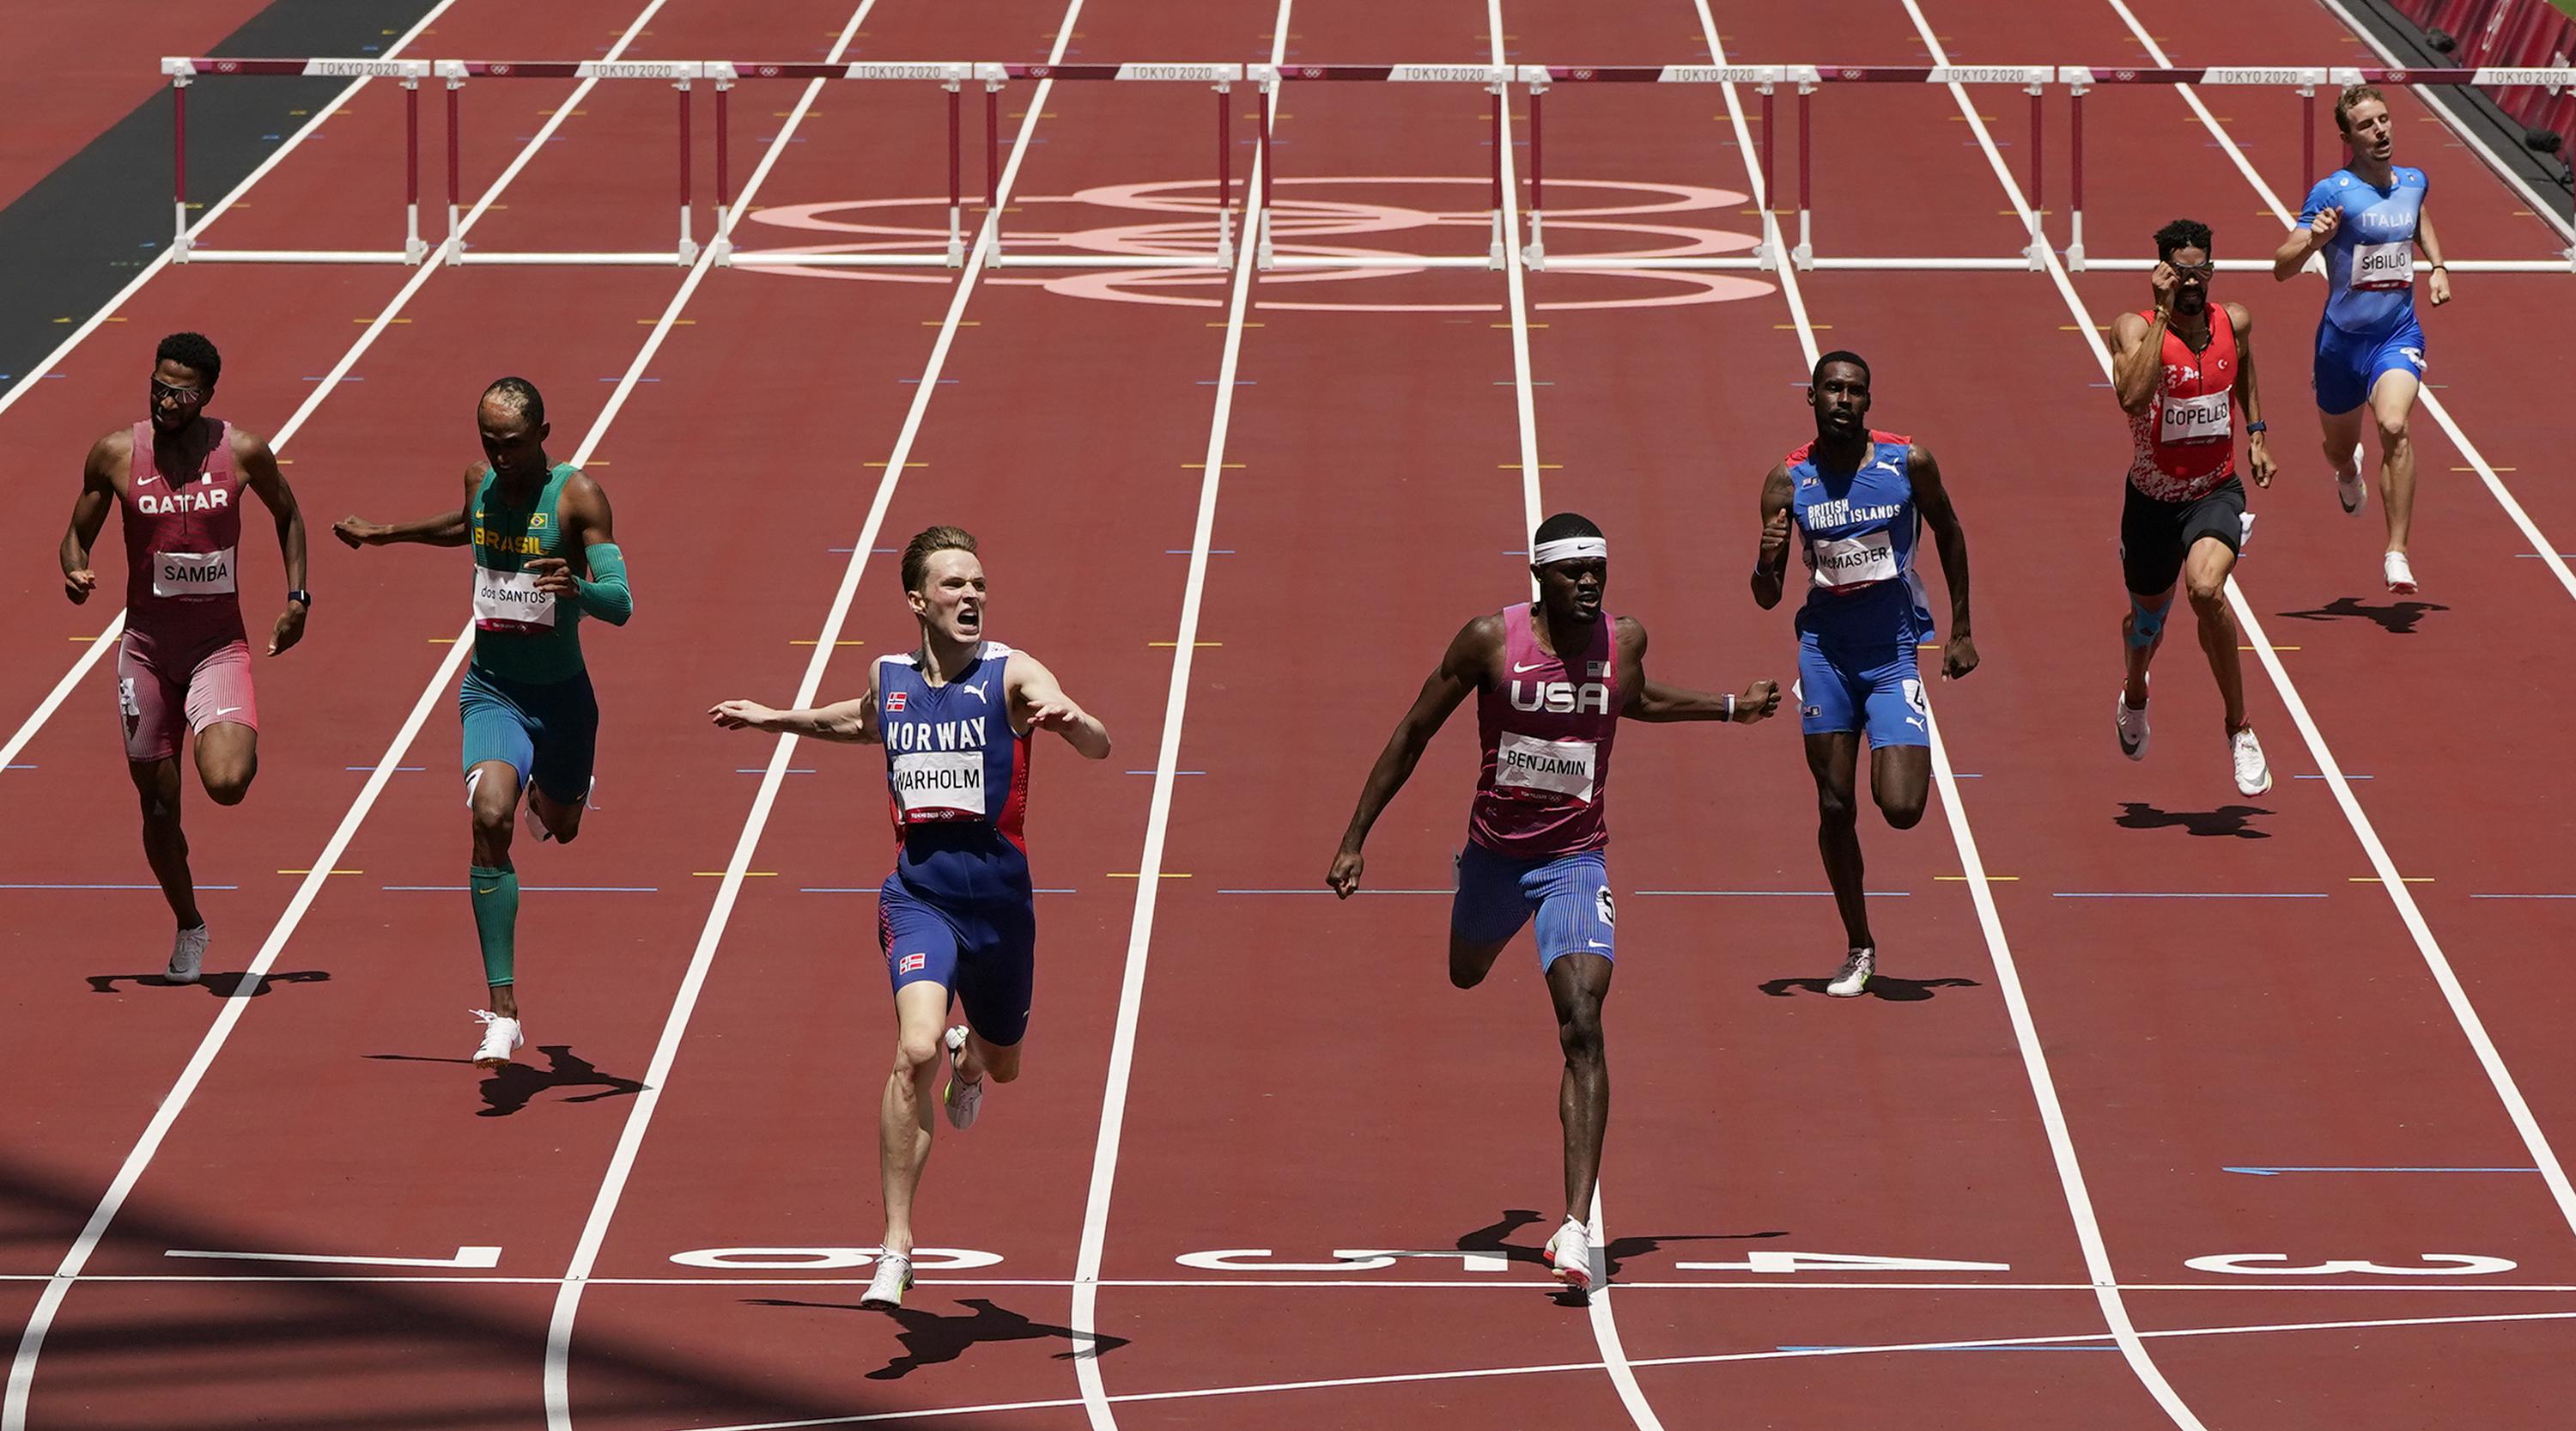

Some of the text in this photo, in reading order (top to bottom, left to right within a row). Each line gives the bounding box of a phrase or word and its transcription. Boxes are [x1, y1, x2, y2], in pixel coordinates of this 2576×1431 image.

[318, 63, 399, 75] TOKYO 2020
[592, 64, 672, 76] TOKYO 2020
[860, 66, 941, 79] TOKYO 2020
[1132, 66, 1212, 79] TOKYO 2020
[1405, 68, 1485, 81] TOKYO 2020
[1674, 69, 1754, 81] TOKYO 2020
[1944, 69, 2025, 82] TOKYO 2020
[2217, 70, 2298, 83] TOKYO 2020
[2488, 71, 2569, 84] TOKYO 2020
[2361, 212, 2414, 228] ITALIA
[2361, 253, 2406, 271] SIBILIO
[2165, 402, 2227, 426] COPELLO
[138, 488, 228, 515] QATAR
[1807, 498, 1850, 519] BRITISH
[1808, 503, 1901, 531] VIRGIN ISLANDS
[474, 527, 549, 556] BRASIL
[1819, 546, 1888, 569] McMASTER
[164, 563, 228, 582] SAMBA
[481, 586, 546, 604] dos SANTOS
[1510, 679, 1609, 715] USA
[887, 716, 987, 751] NORWAY
[1507, 750, 1586, 776] BENJAMIN
[895, 769, 980, 792] WARHOLM
[163, 1246, 502, 1268] 7
[668, 1246, 1005, 1270] 6
[1175, 1249, 1509, 1271] 5
[1675, 1251, 2011, 1274] 4
[2183, 1252, 2518, 1276] 3
